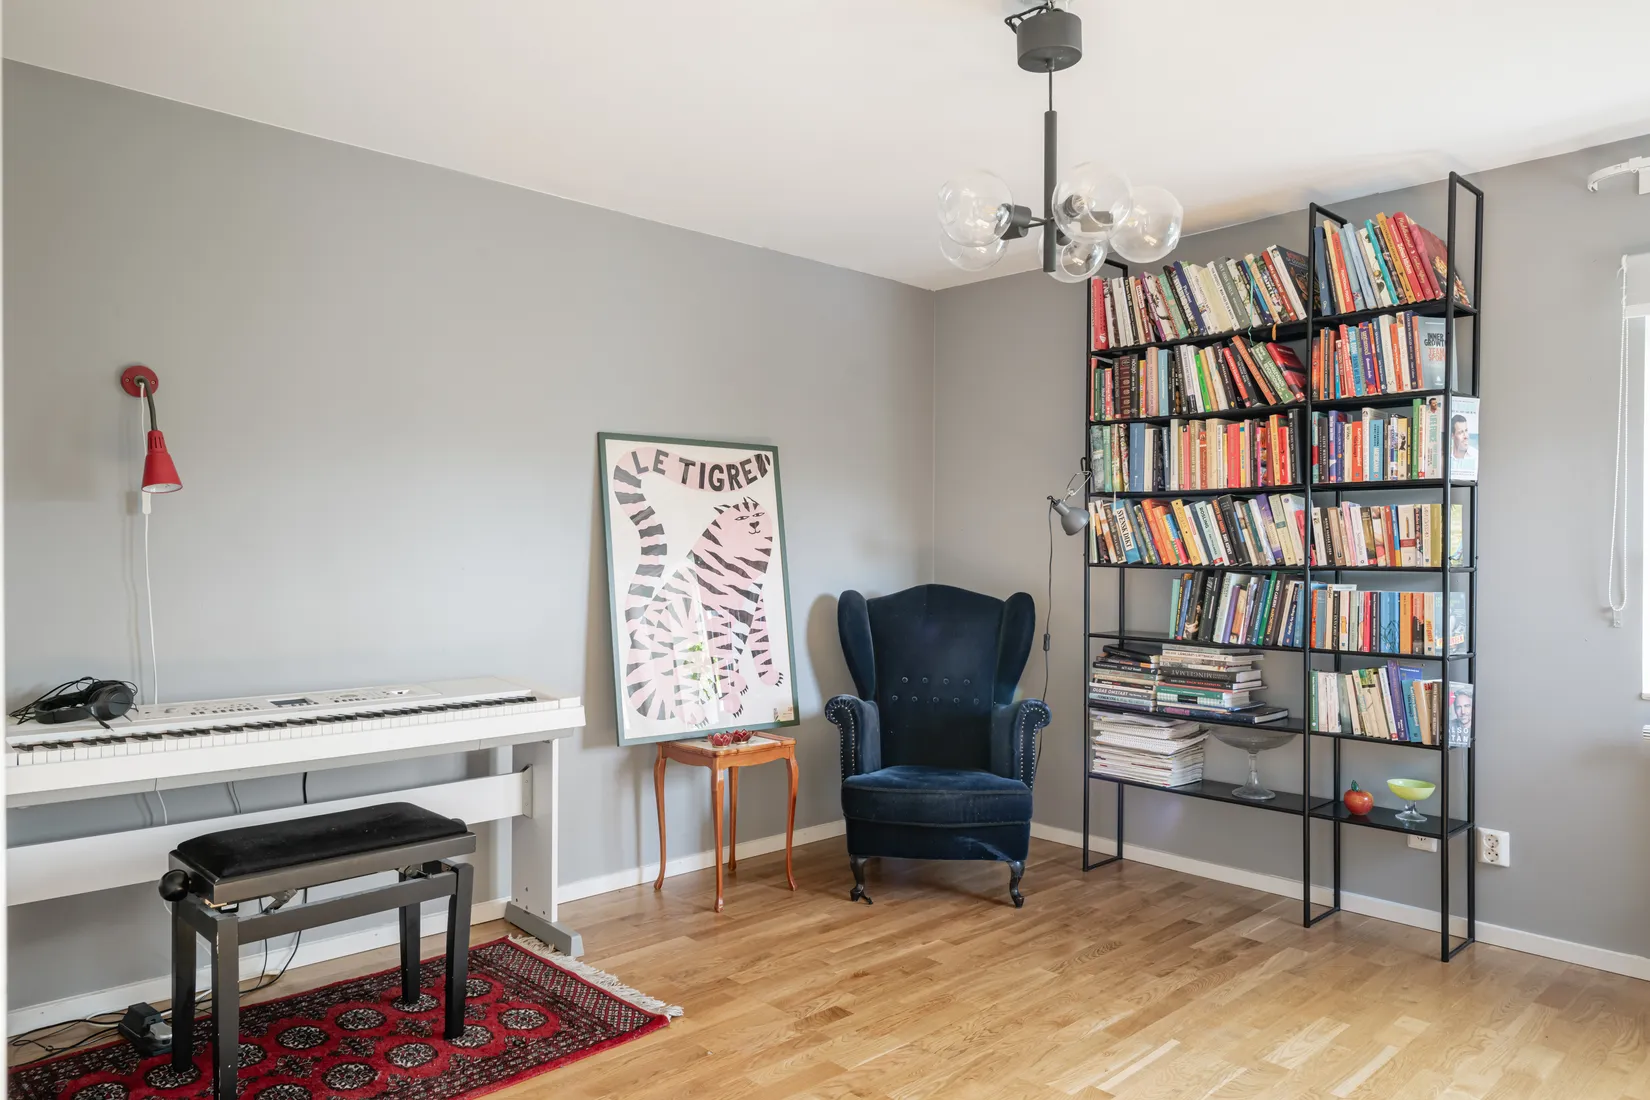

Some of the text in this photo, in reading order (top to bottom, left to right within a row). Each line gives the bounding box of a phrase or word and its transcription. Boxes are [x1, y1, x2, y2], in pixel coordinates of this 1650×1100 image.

[631, 449, 758, 492] LE TIGRE
[1116, 509, 1133, 549] SVENSK DIKT
[1198, 506, 1210, 529] ROSLING
[1171, 669, 1213, 680] MINGELMAT
